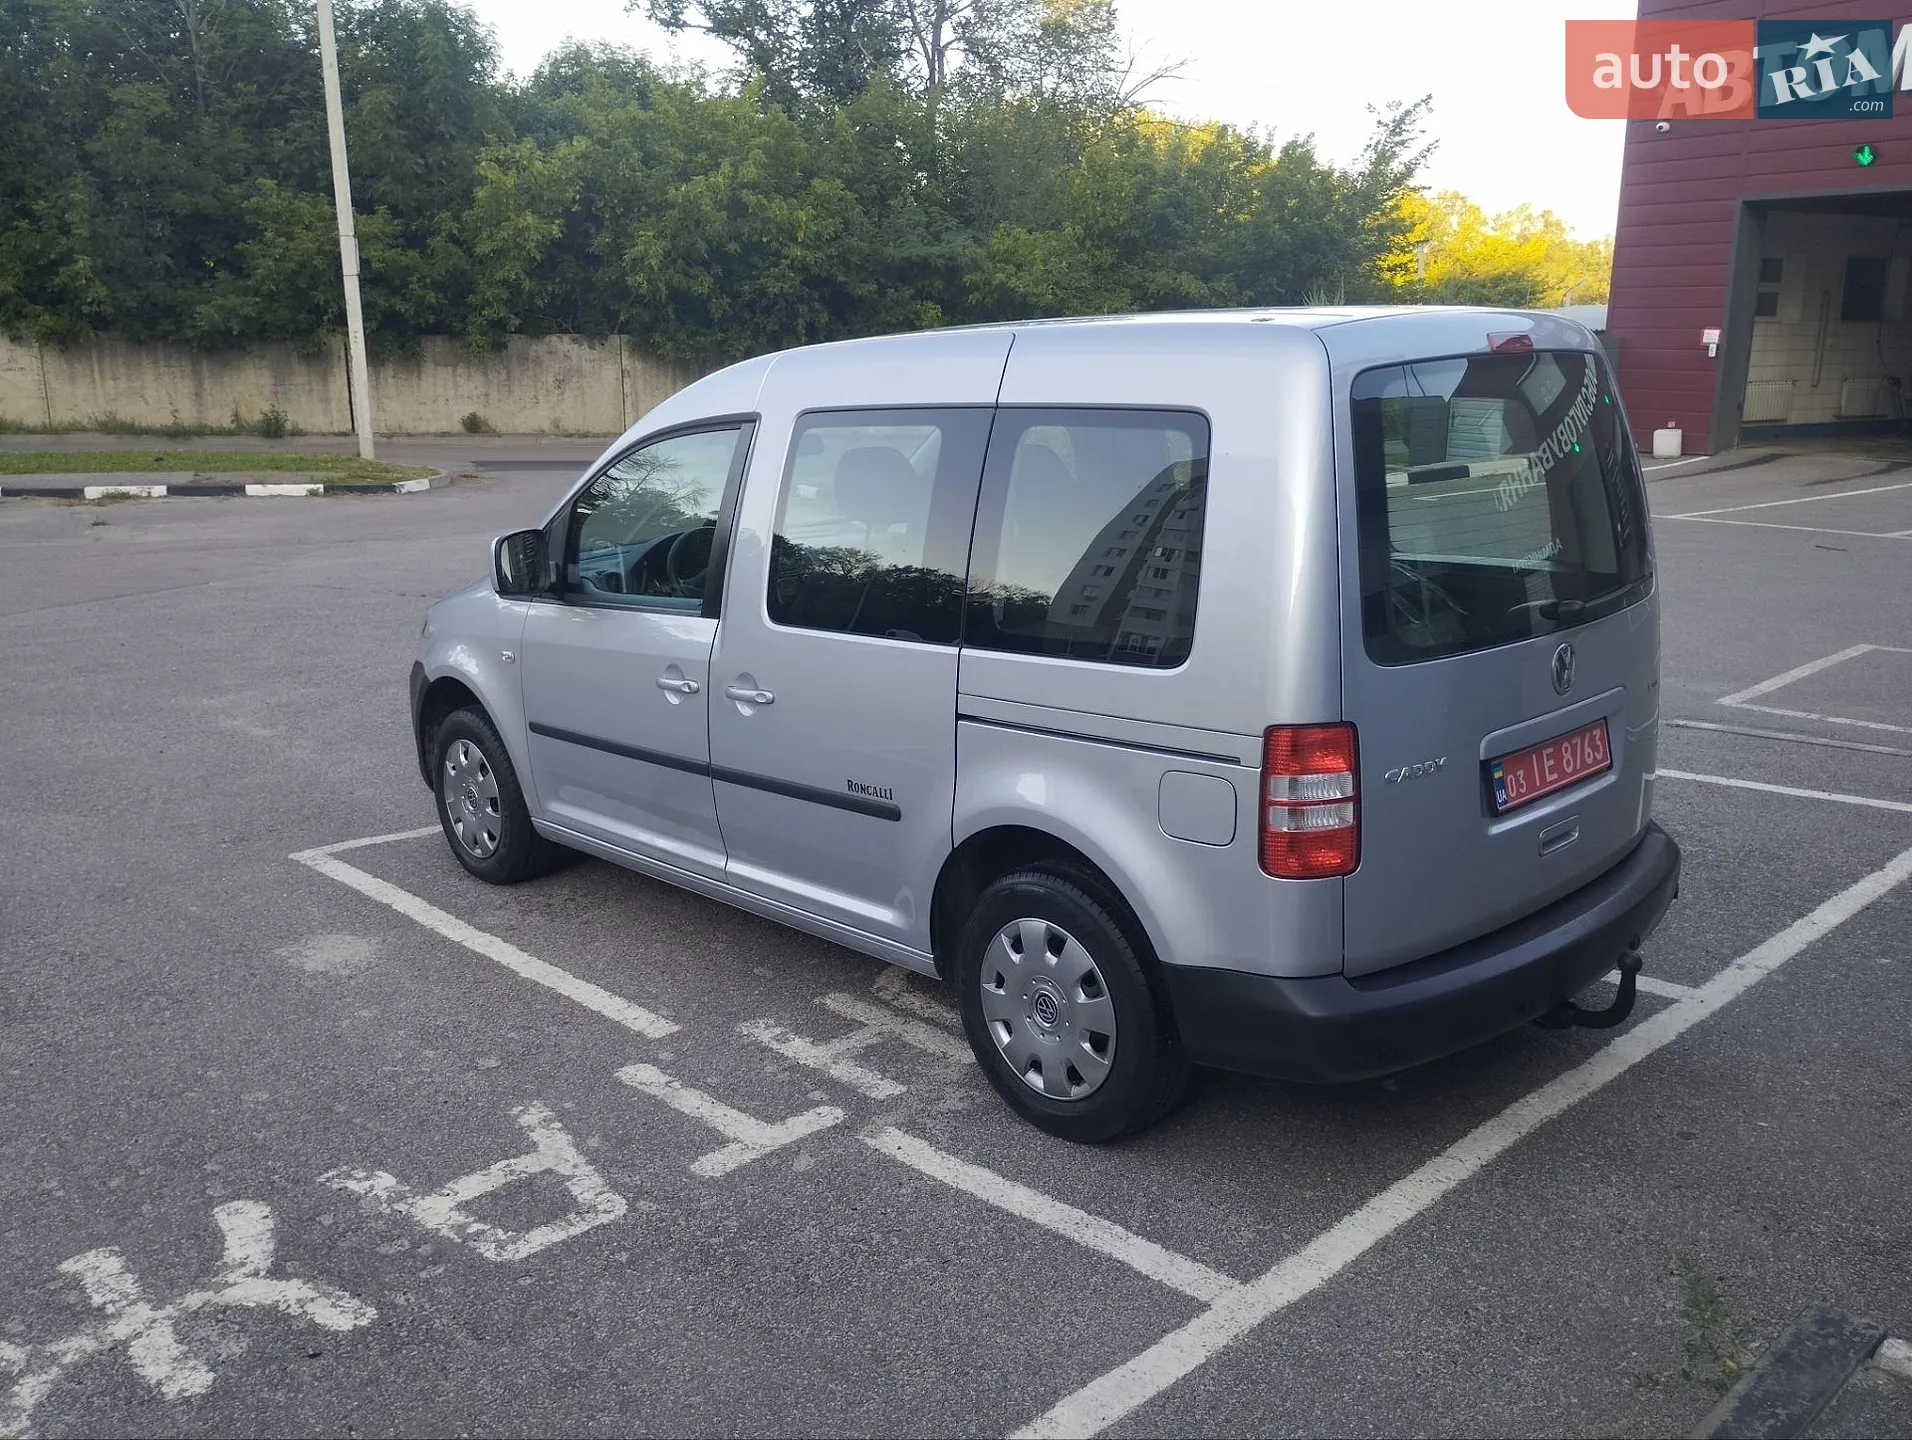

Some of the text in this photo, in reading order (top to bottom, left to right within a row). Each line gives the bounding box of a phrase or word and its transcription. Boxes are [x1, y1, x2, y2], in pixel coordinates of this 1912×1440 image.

[1384, 756, 1447, 783] CADDY
[1496, 728, 1604, 803] UA 03 IE 8763
